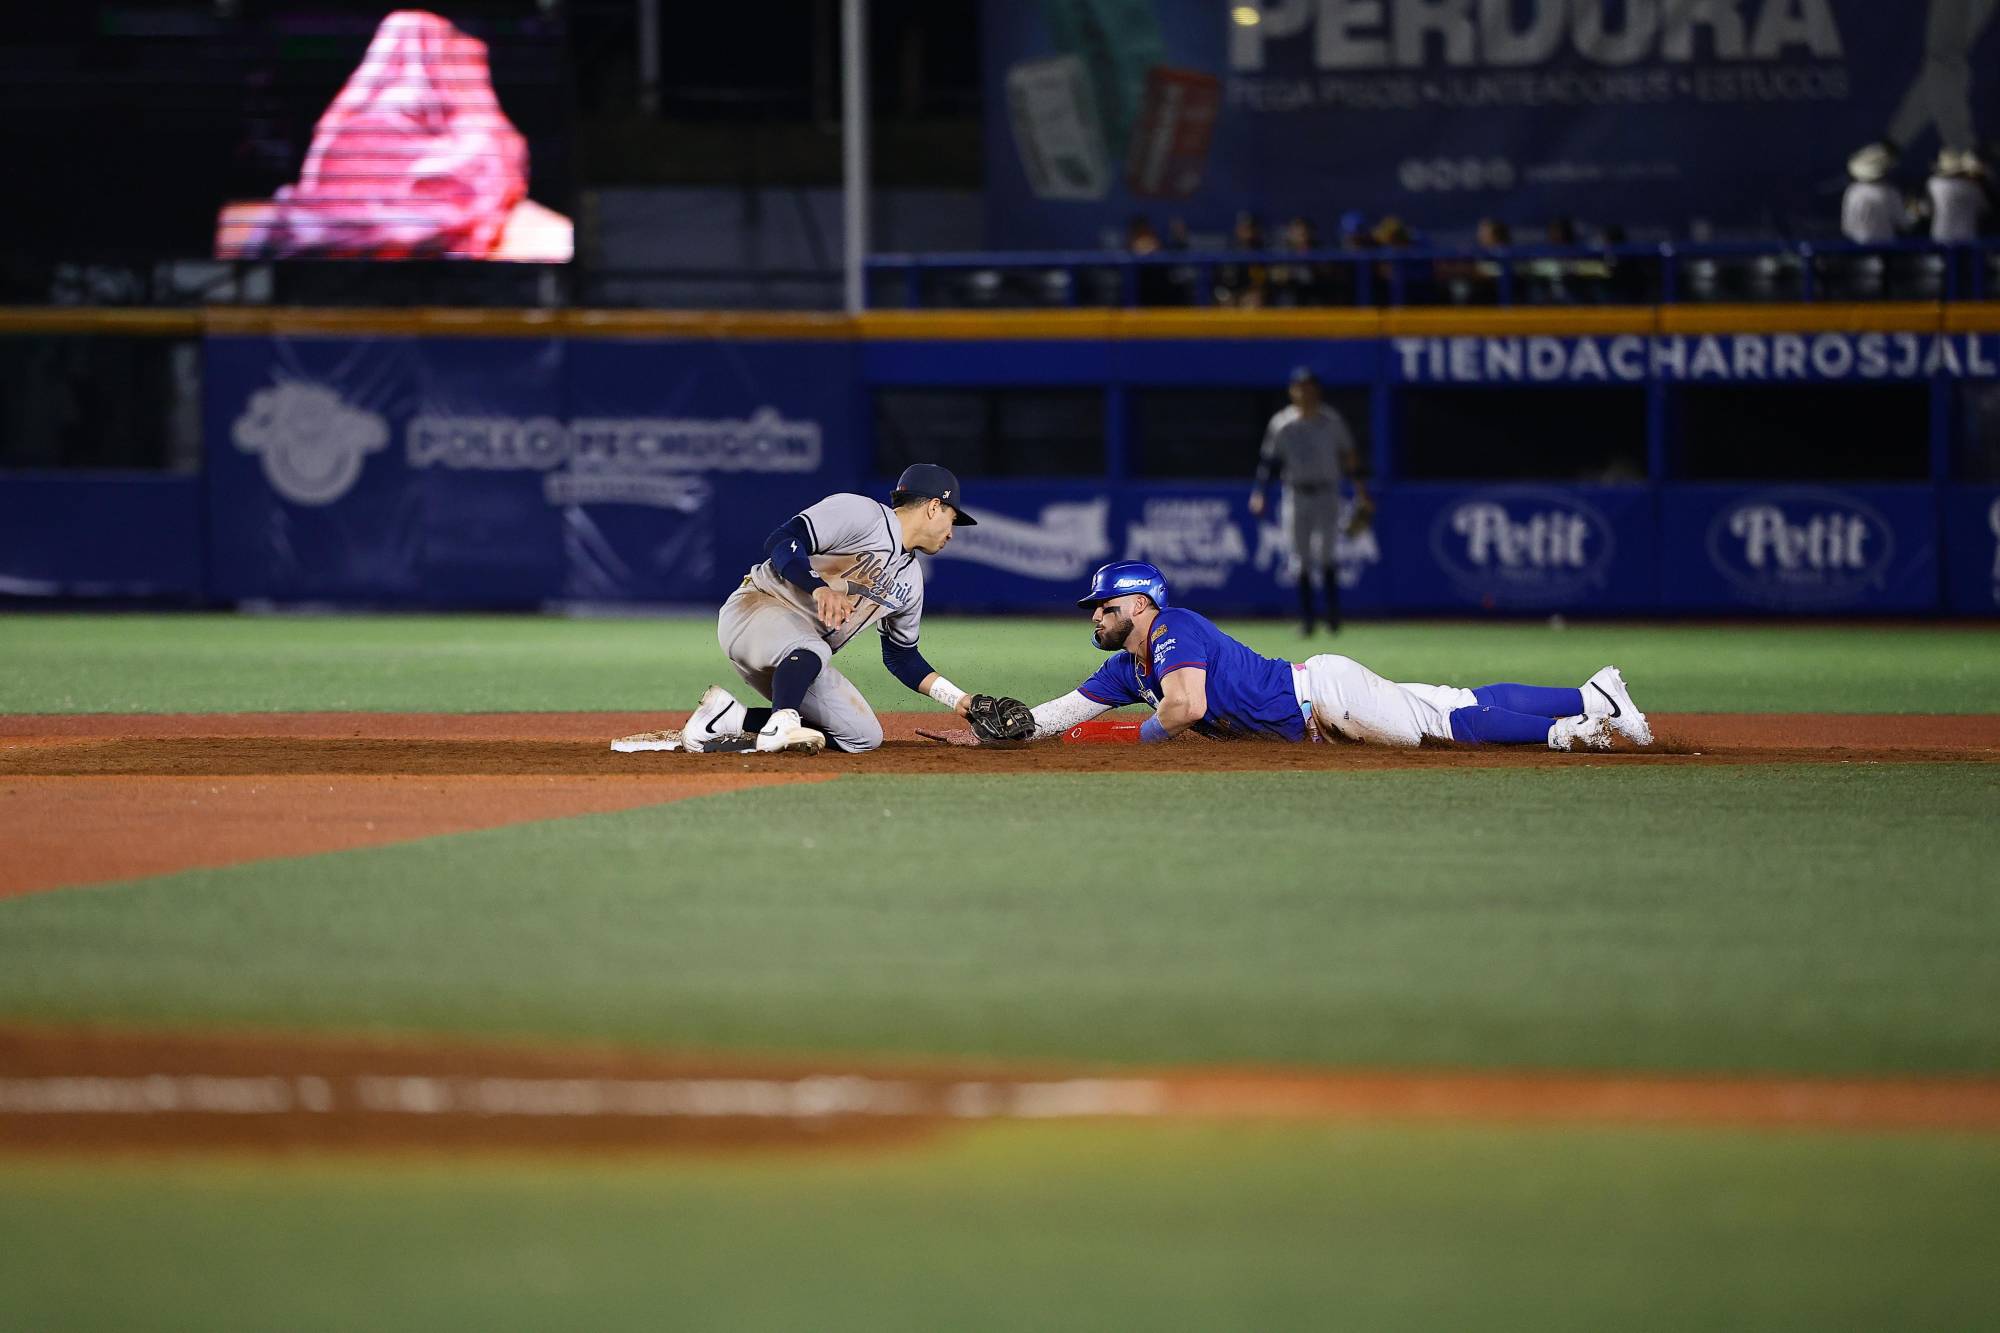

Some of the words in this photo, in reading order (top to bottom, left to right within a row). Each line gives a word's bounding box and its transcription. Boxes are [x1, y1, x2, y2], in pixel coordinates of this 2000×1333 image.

[1228, 0, 1844, 69] PERDURA
[1392, 331, 1997, 381] TIENDACHARROSJAL
[1453, 502, 1589, 568] Petit
[1730, 505, 1871, 569] Petit
